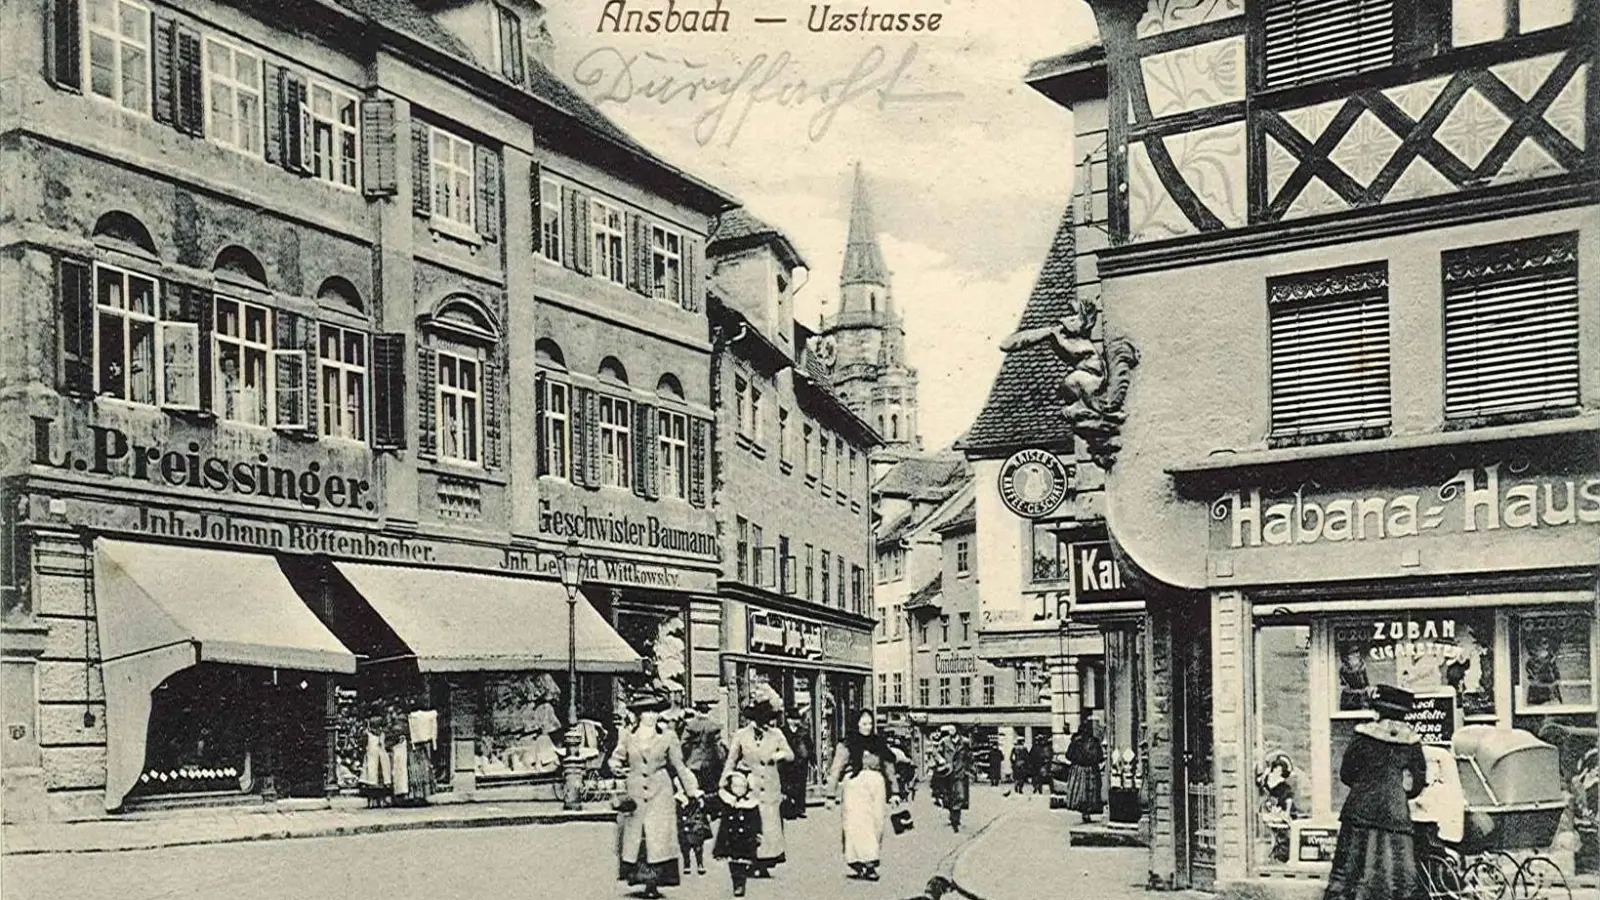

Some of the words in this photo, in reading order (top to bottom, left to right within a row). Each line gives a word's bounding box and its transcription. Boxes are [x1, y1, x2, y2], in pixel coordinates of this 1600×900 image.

[191, 514, 283, 548] Johann
[538, 499, 646, 546] Geschwister
[647, 516, 717, 556] Baumann
[1373, 620, 1455, 640] ZUBAN
